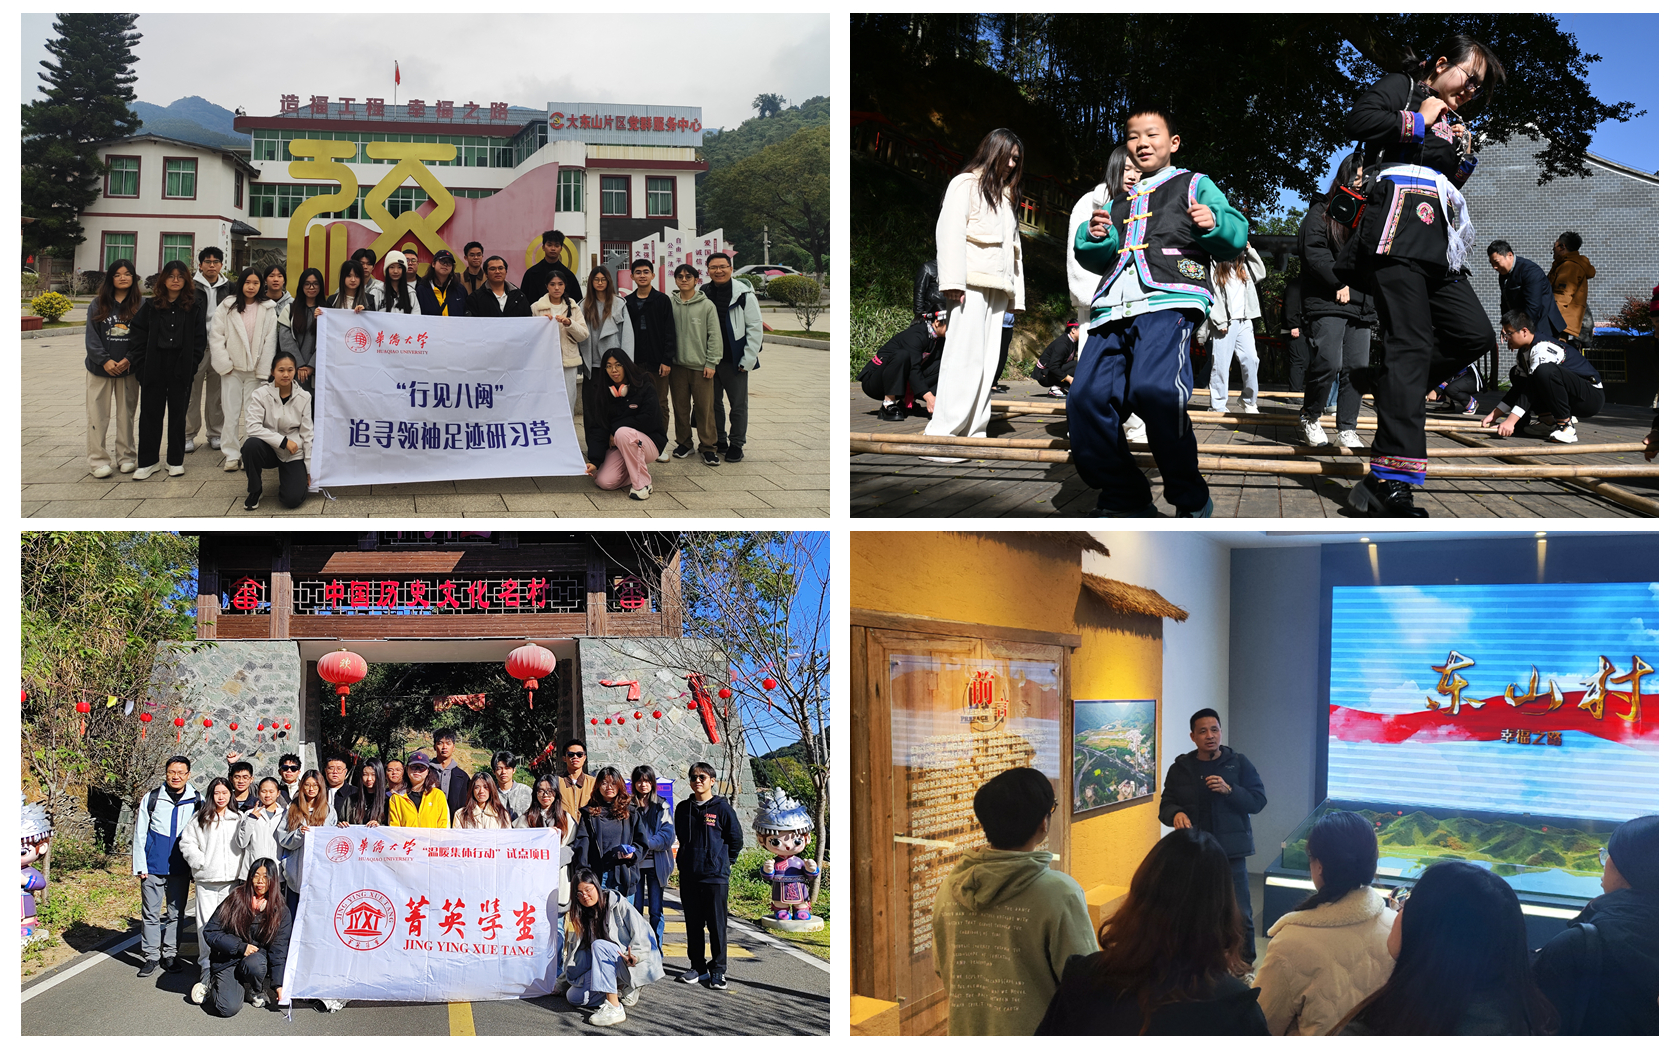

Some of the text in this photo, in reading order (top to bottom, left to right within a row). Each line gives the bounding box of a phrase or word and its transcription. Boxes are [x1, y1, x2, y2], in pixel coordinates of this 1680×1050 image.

[280, 94, 509, 120] 造福工程 幸福之路
[566, 113, 702, 132] 大东山片区党群服务中心
[348, 418, 552, 450] 追寻领袖足迹研习营
[325, 577, 550, 610] 中国历史文化名村
[1425, 650, 1655, 722] 东山村
[1500, 728, 1563, 747] 幸福之路
[506, 848, 550, 860] 试点项目
[403, 939, 534, 957] JING YING XUE TANG
